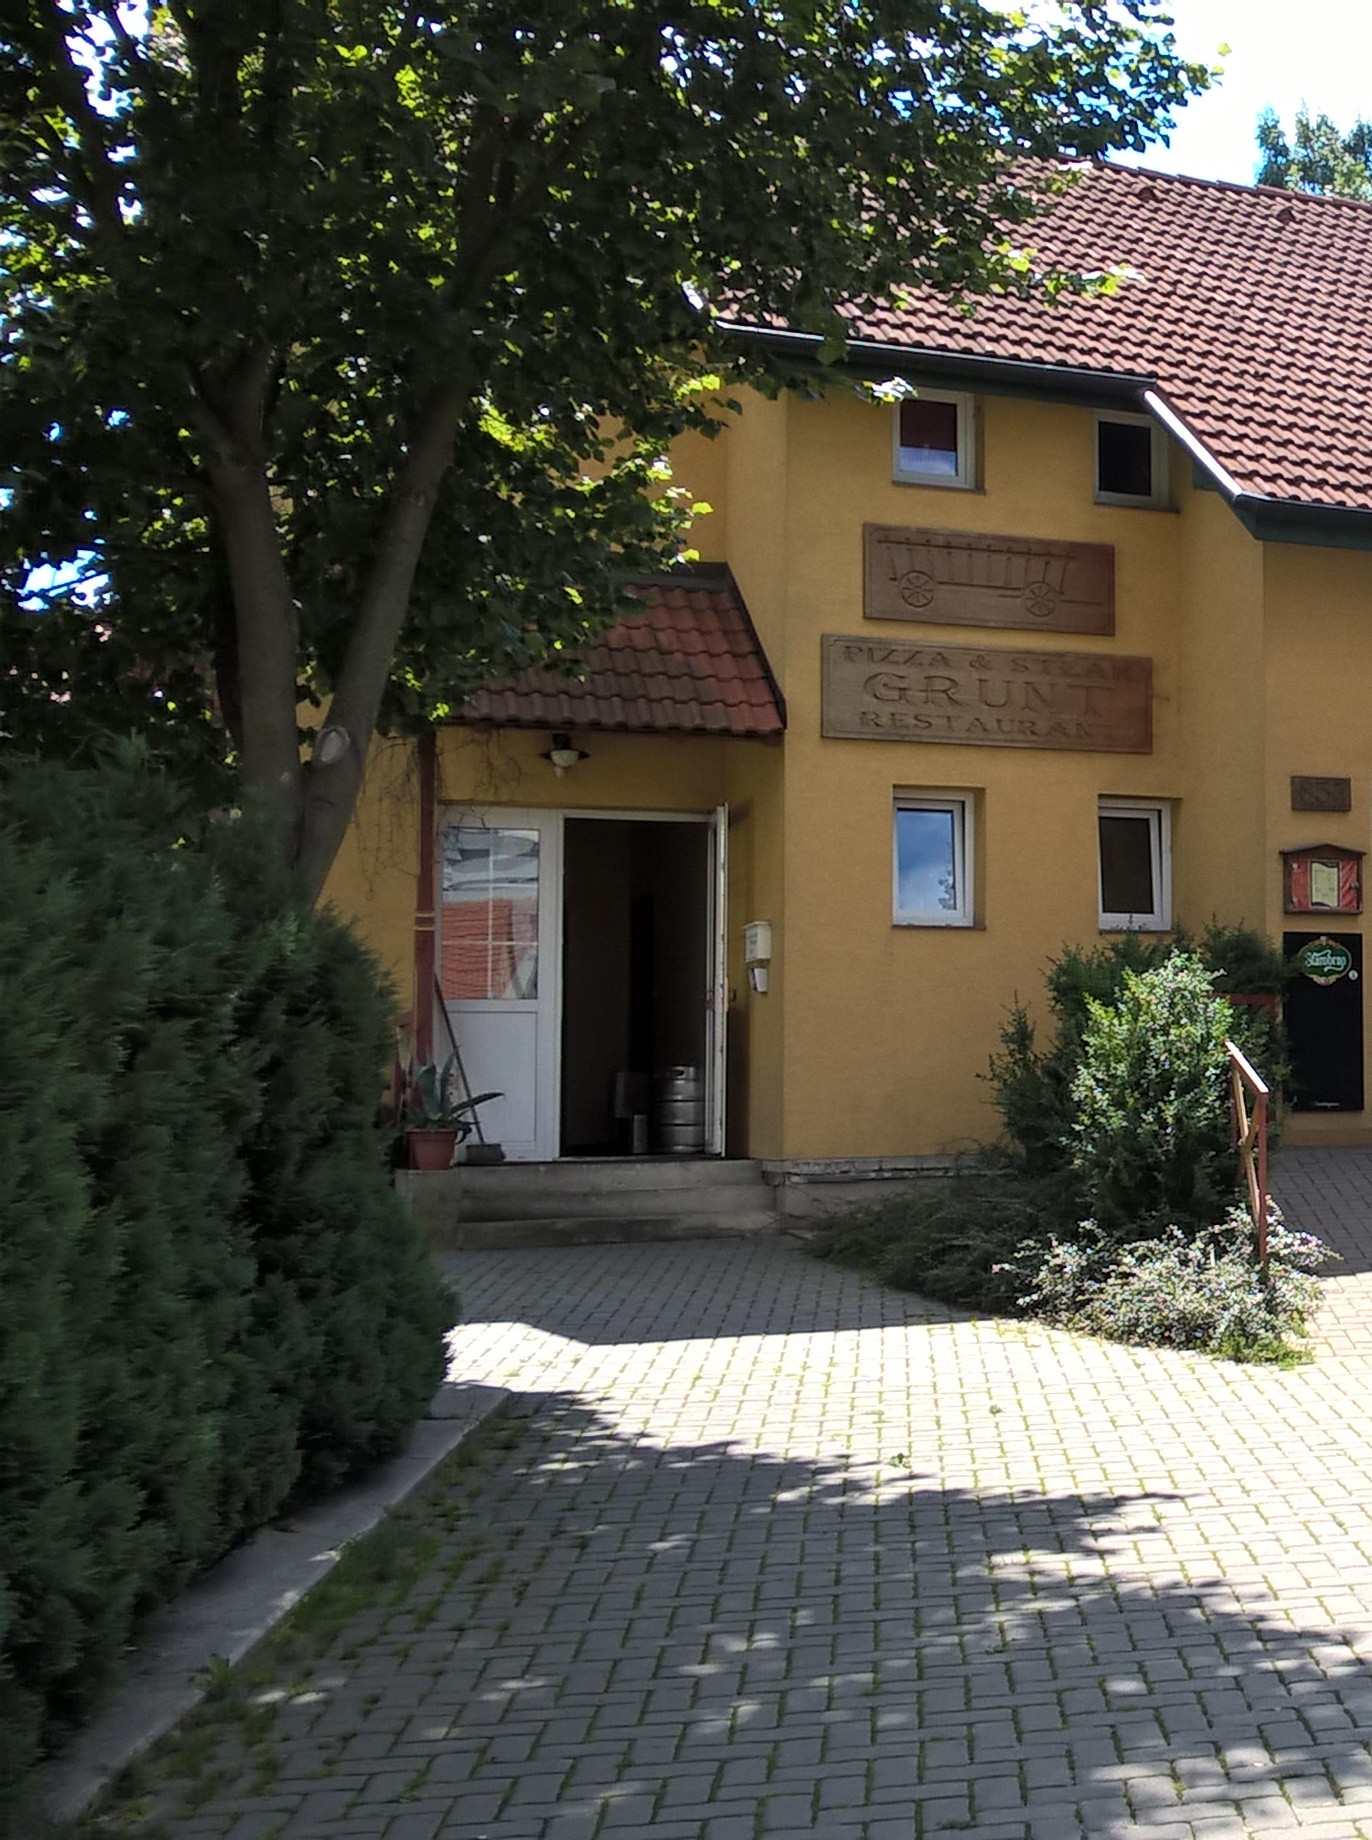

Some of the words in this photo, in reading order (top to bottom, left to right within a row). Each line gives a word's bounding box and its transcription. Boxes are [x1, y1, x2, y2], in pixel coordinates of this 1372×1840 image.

[843, 645, 951, 668] PIZZA
[969, 654, 991, 671] &
[863, 672, 1114, 717] GRUNT
